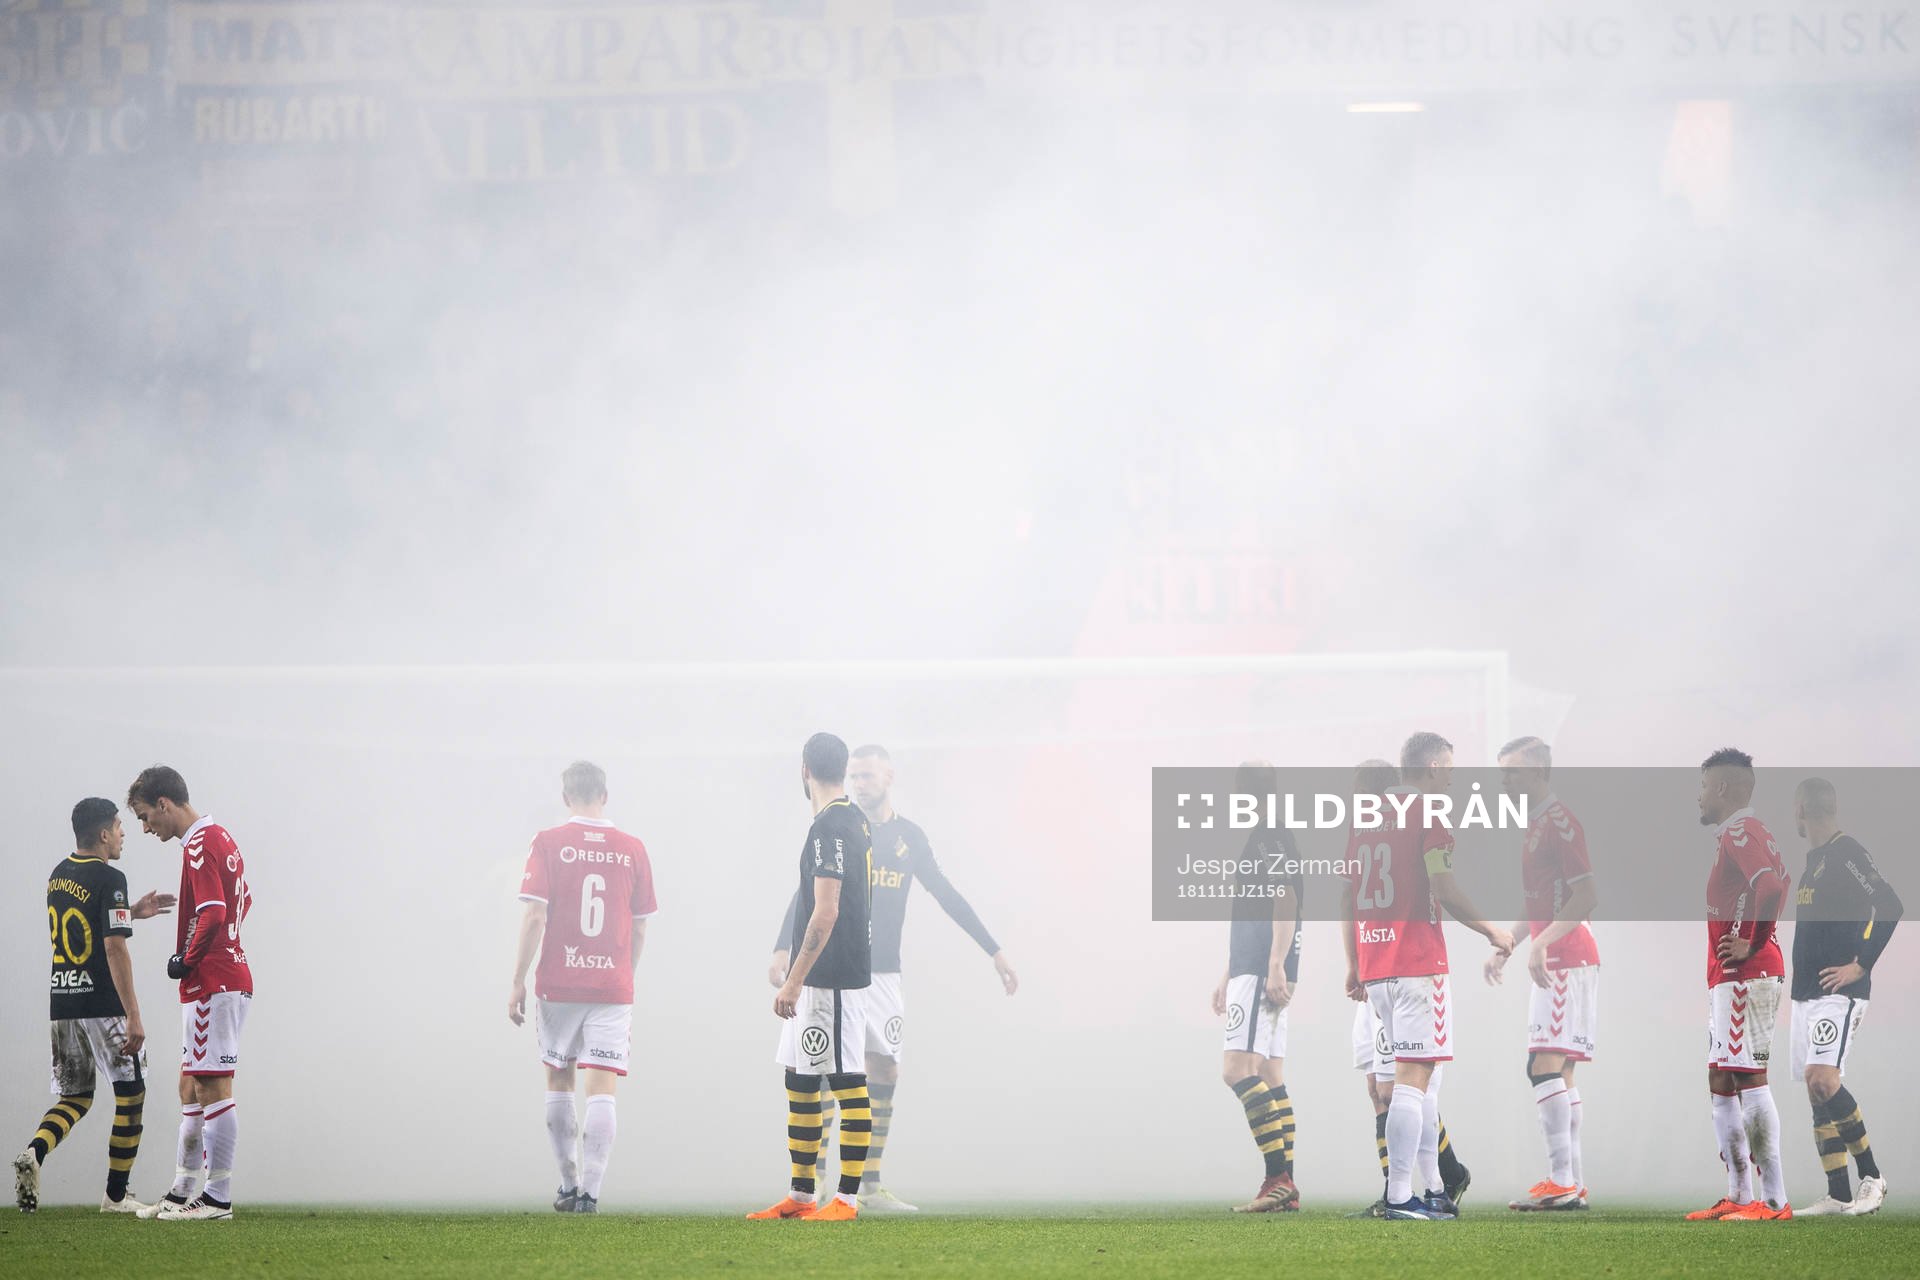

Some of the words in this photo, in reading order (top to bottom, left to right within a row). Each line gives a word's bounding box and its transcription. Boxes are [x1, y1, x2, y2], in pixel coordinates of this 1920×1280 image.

[1356, 843, 1395, 911] 23
[580, 873, 606, 938] 6
[49, 905, 93, 966] 20
[1359, 927, 1397, 944] RASTA
[51, 968, 94, 988] SVEA
[564, 954, 616, 969] RASTA
